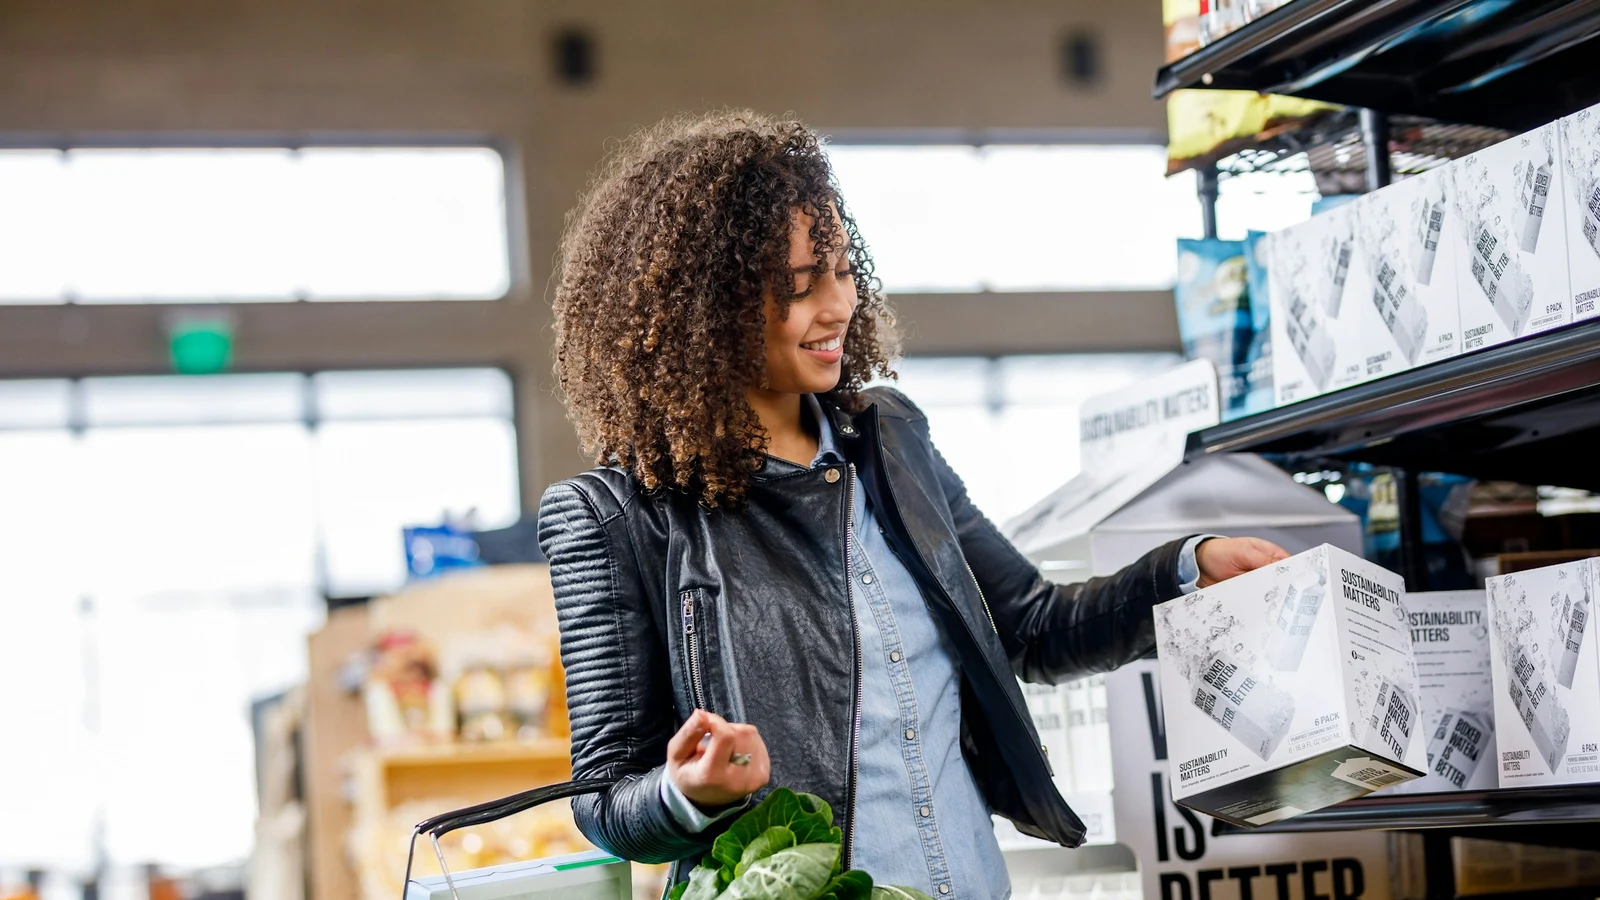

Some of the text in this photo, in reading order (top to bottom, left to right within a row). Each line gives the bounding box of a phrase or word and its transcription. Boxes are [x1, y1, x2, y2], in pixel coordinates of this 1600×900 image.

[1550, 301, 1563, 313] PACK
[1341, 568, 1400, 606] SUSTAINABILITY
[1343, 584, 1380, 612] MATTERS
[1409, 610, 1481, 626] STAINABILITY
[1410, 628, 1450, 642] ATTERS
[1203, 659, 1226, 684] BOXED
[1212, 665, 1236, 691] WATER
[1221, 686, 1234, 699] IS
[1390, 691, 1410, 722] BOXED
[1314, 711, 1340, 727] 6 PACK
[1384, 713, 1392, 729] IS
[1387, 702, 1407, 736] WATER
[1455, 717, 1481, 744] BOXED
[1442, 745, 1453, 760] IS
[1449, 731, 1476, 760] WATER
[1586, 743, 1598, 752] PACK
[1179, 748, 1228, 772] SUSTAINABILITY
[1181, 764, 1210, 782] MATTERS
[1150, 772, 1206, 862] IS
